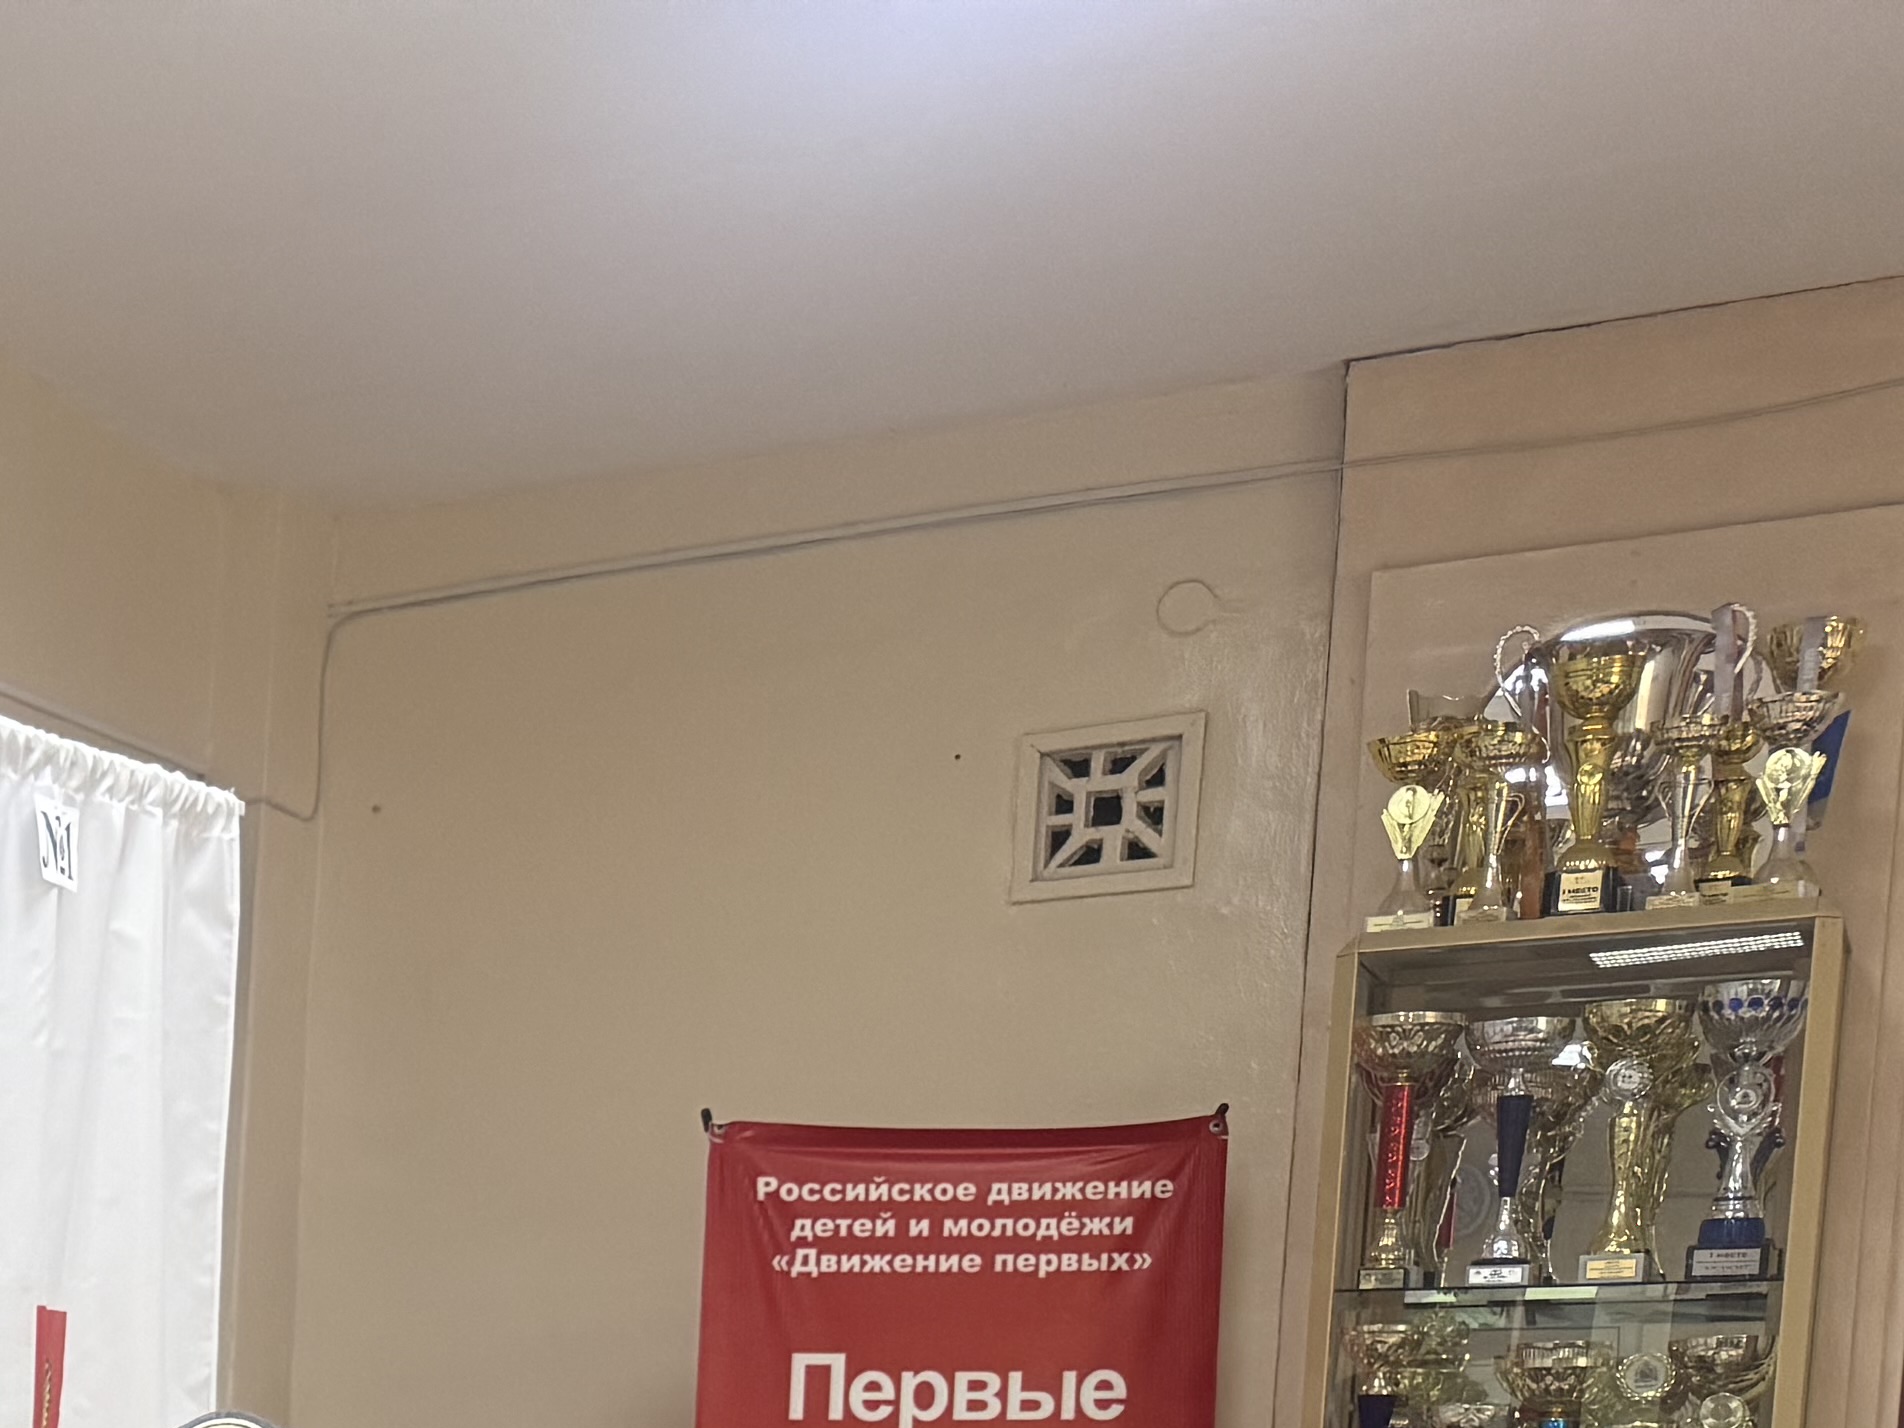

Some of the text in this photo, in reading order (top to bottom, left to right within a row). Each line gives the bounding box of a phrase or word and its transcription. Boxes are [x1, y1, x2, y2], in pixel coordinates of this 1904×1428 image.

[40, 809, 75, 882] №1
[756, 1177, 1174, 1205] Российское движение
[791, 1212, 1134, 1241] детей и молодёжи
[771, 1249, 1153, 1277] «Движение первых»
